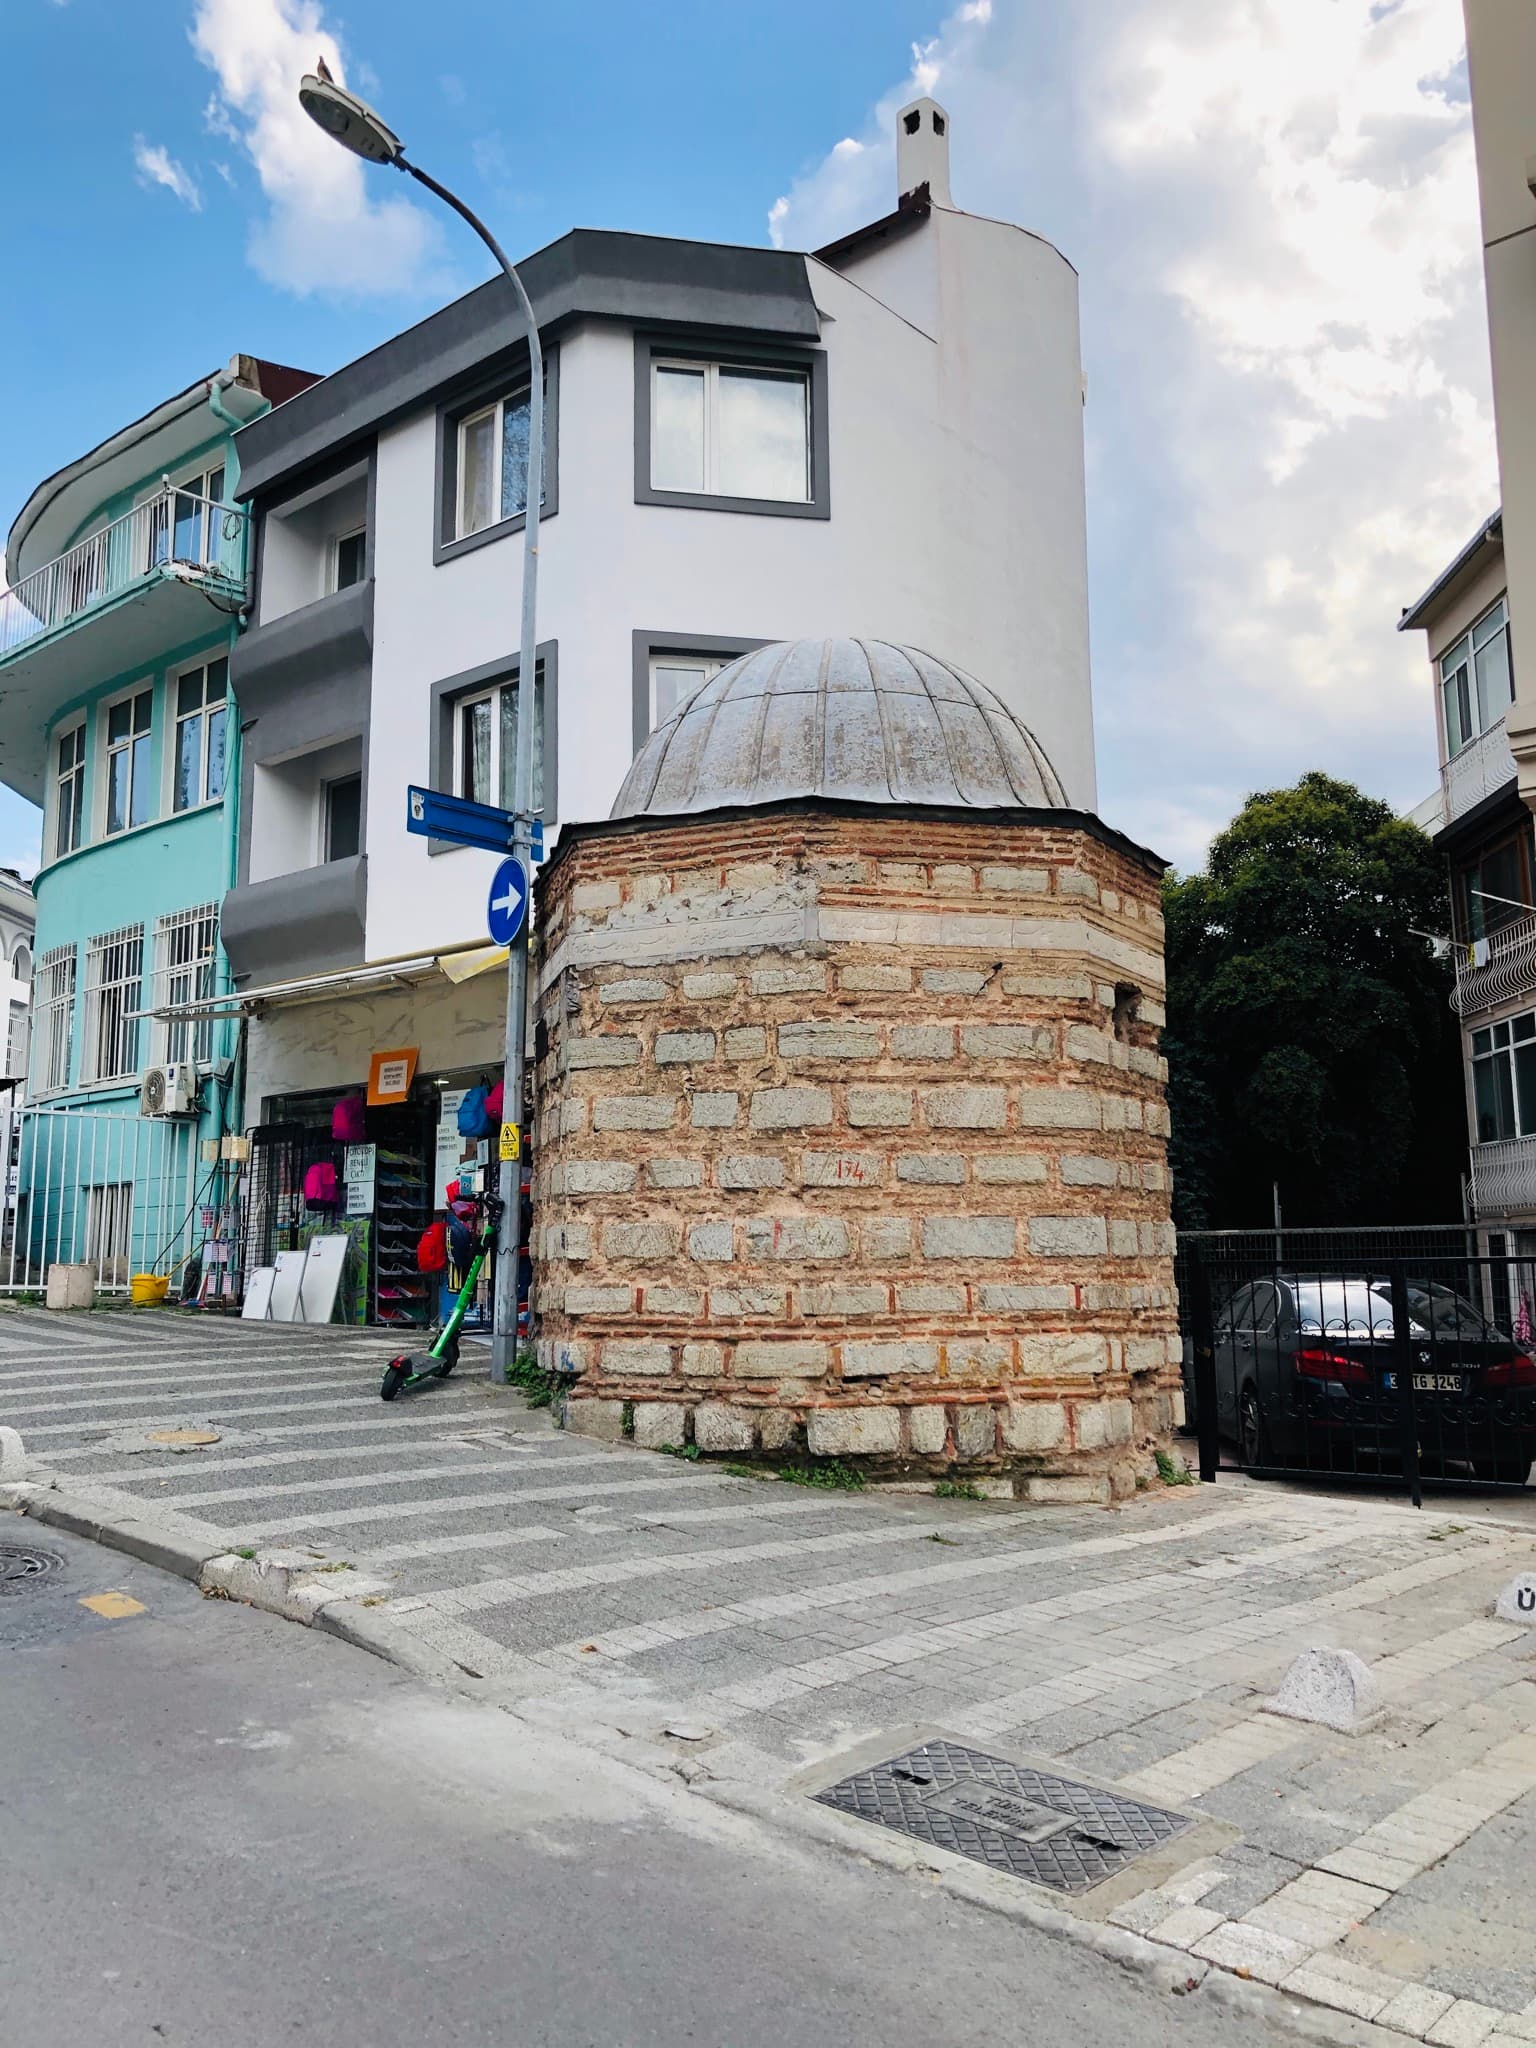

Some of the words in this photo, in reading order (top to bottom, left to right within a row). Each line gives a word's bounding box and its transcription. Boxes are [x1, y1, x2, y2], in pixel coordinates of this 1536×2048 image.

[837, 1158, 864, 1184] 174
[1413, 1376, 1428, 1388] TG
[1432, 1376, 1461, 1389] 3248
[952, 1798, 1035, 1831] TELEKOM
